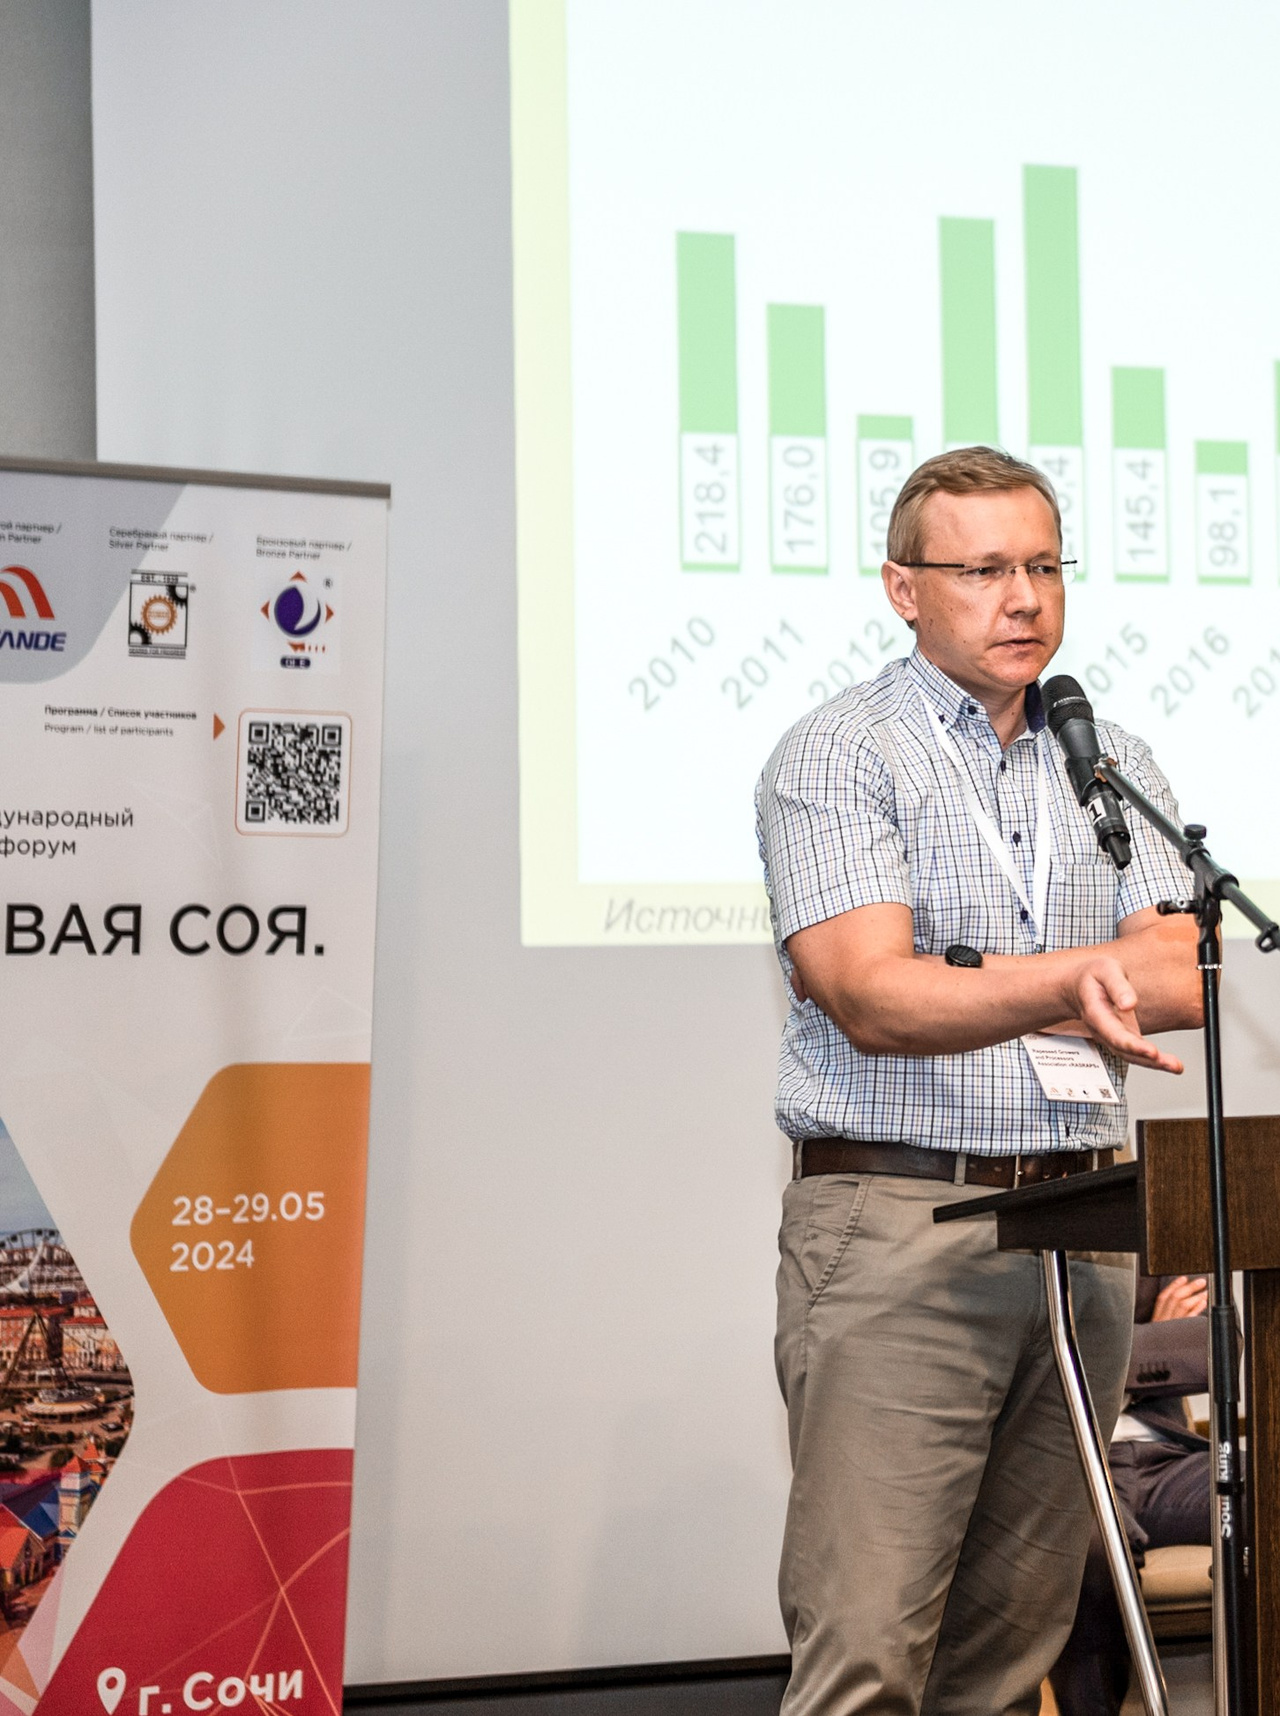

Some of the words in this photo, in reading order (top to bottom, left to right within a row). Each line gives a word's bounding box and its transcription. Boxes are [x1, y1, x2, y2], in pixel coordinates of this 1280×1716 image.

[694, 443, 728, 554] 218,4
[782, 445, 817, 553] 176,0
[1125, 459, 1157, 560] 145,4
[8, 533, 41, 544] Partner
[109, 540, 133, 549] Silver
[136, 541, 169, 552] Partner
[1208, 488, 1241, 567] 98,1
[256, 548, 286, 559] Bronze
[288, 550, 320, 561] Partner
[0, 630, 67, 652] ANDE
[629, 616, 716, 711] 2010
[721, 618, 804, 710] 2011
[1091, 621, 1149, 707] 015
[1150, 626, 1230, 717] 2016
[44, 722, 84, 734] Program
[94, 724, 106, 734] list
[109, 725, 119, 735] of
[120, 726, 174, 738] participants
[45, 705, 98, 718] Программа
[107, 706, 142, 718] Список
[144, 708, 197, 720] участников
[0, 808, 134, 829] ународный
[1088, 803, 1103, 826] 1
[169, 903, 324, 956] СОЯ.
[171, 1191, 325, 1226] 28-29.05
[170, 1239, 255, 1272] 2024
[139, 1685, 173, 1715] г.
[183, 1669, 304, 1711] Сочи
